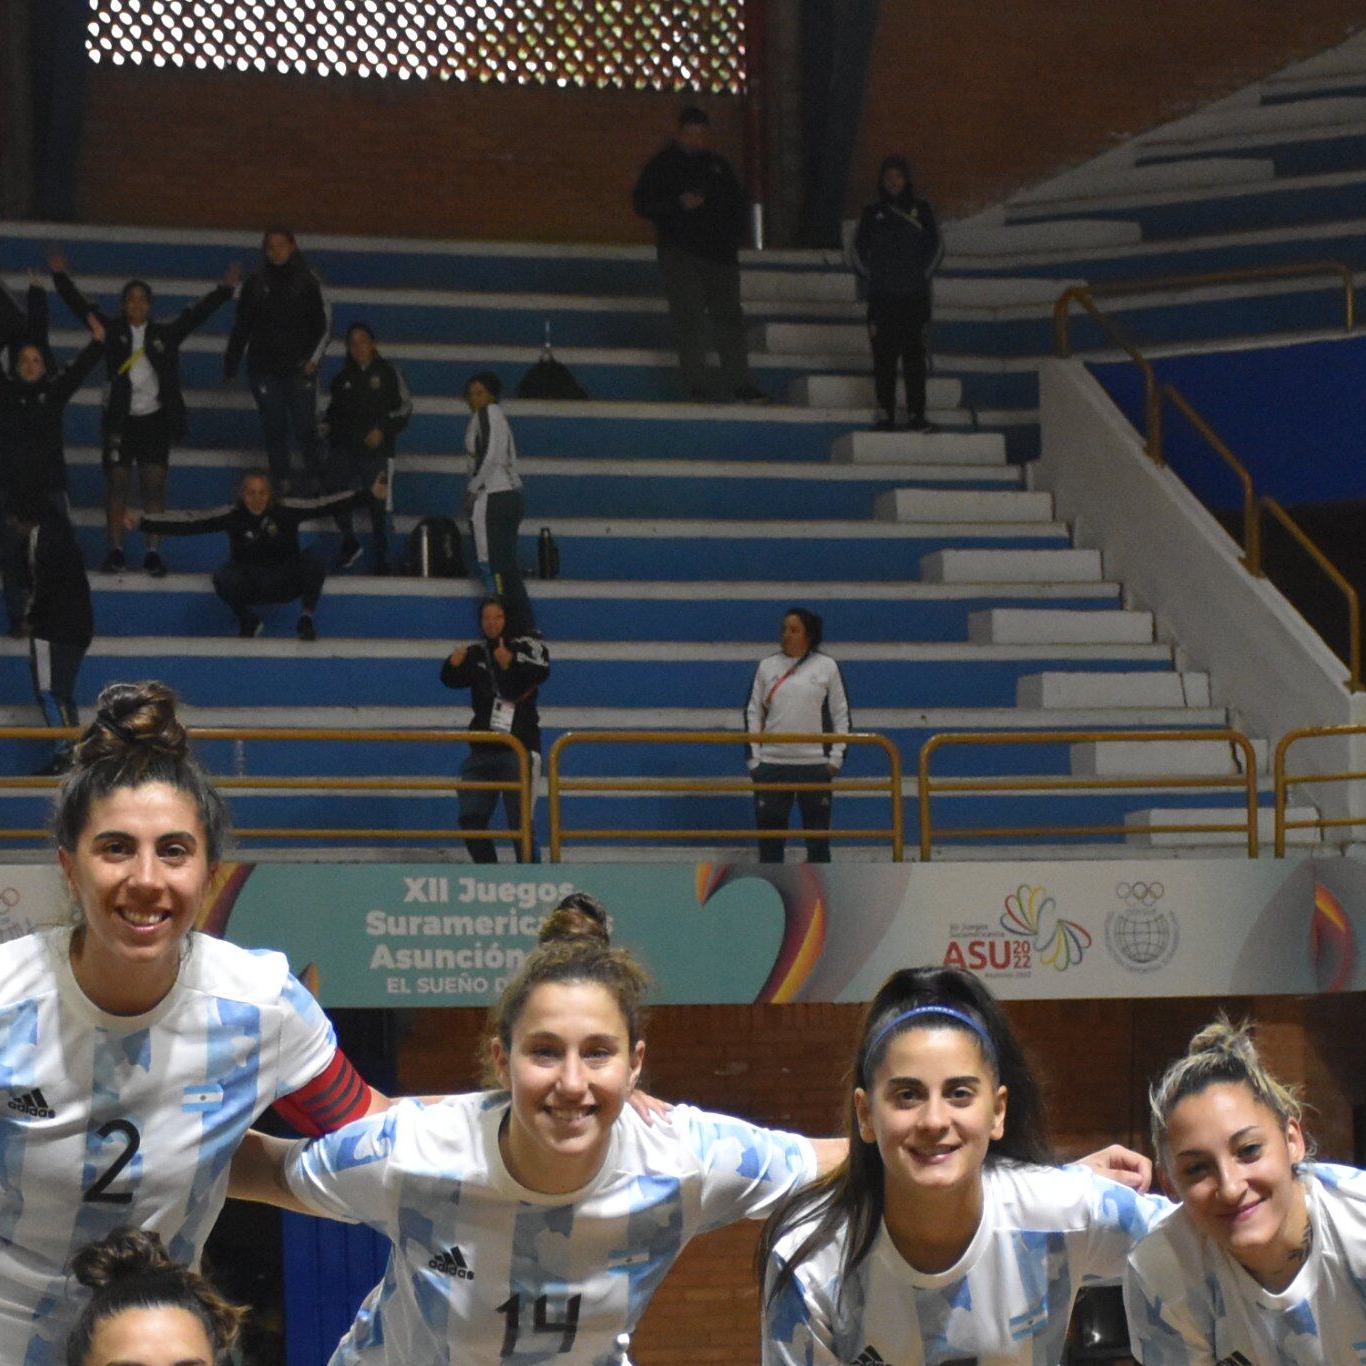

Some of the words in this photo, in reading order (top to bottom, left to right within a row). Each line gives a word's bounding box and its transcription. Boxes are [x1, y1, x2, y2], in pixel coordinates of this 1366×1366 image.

[403, 878, 453, 903] XII
[456, 876, 575, 911] Juegos
[369, 942, 521, 971] Asunción
[942, 940, 1012, 970] ASU
[387, 977, 411, 994] EL
[417, 972, 489, 995] SUEÑO
[7, 1099, 56, 1119] adidas
[82, 1119, 141, 1204] 2
[428, 1258, 475, 1281] adidas
[495, 1292, 583, 1358] 14
